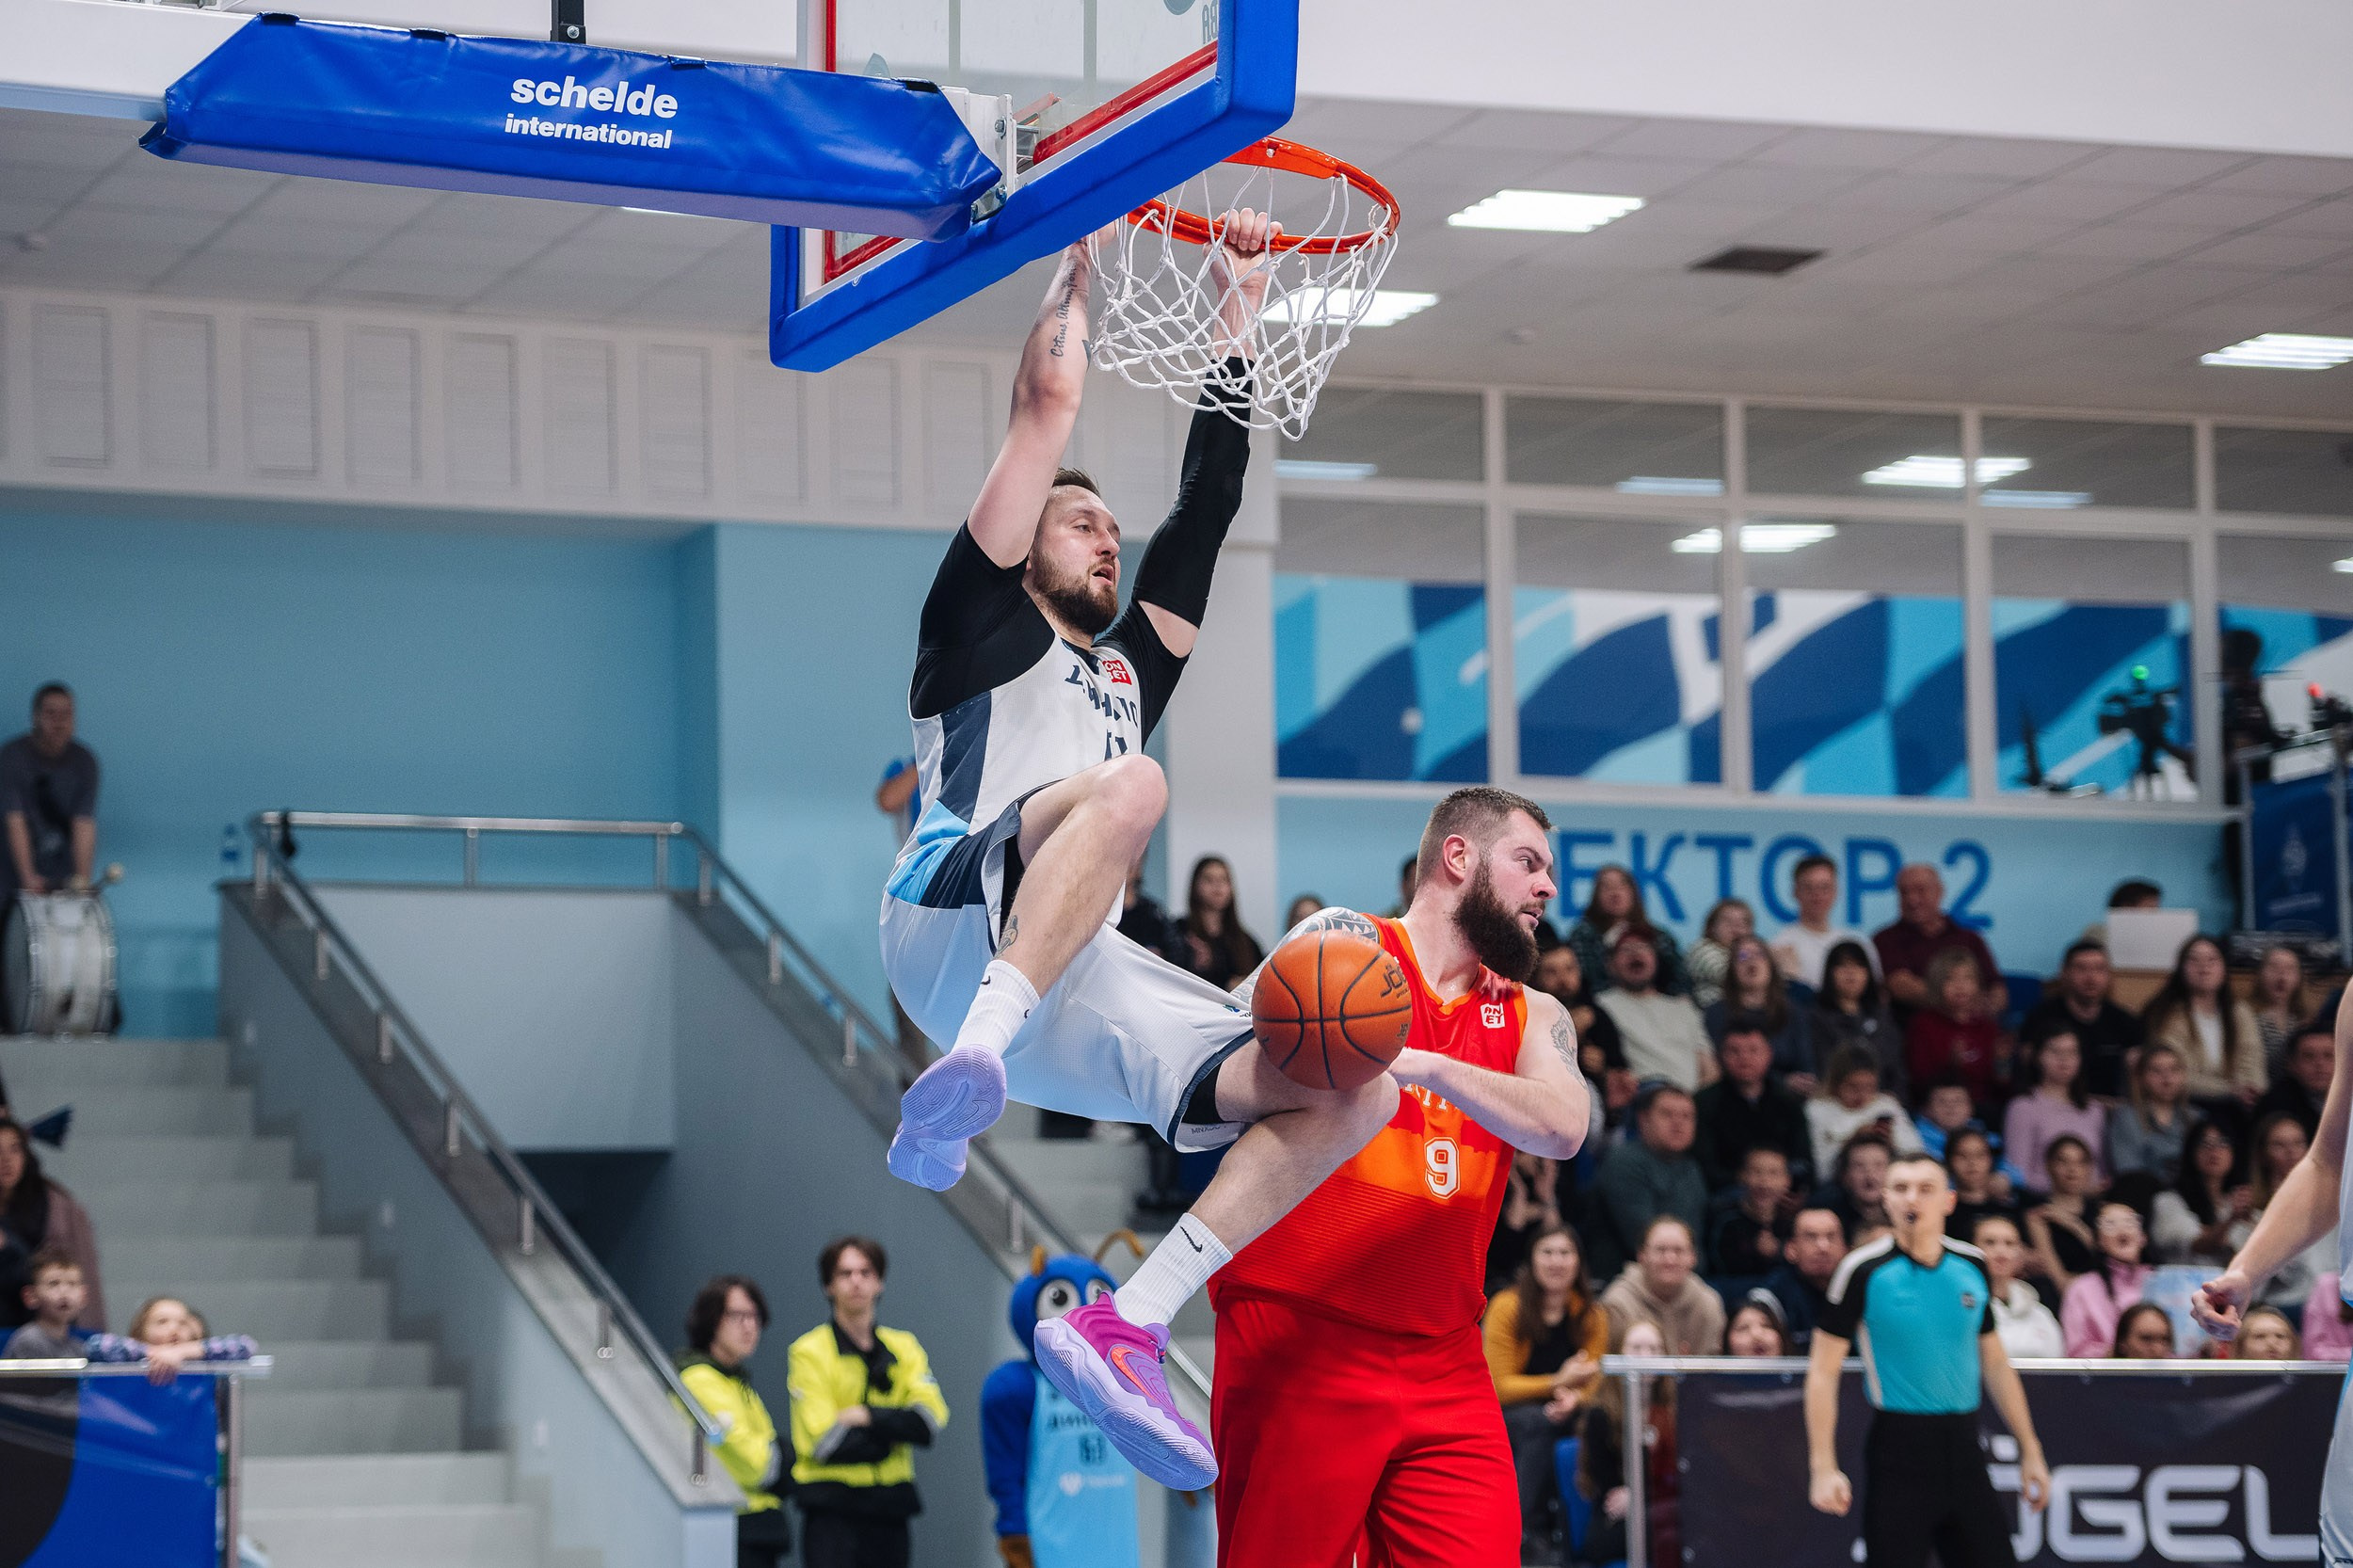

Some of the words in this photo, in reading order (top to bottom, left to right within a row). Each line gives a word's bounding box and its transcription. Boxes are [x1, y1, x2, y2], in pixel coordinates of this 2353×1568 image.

[510, 75, 678, 119] schelde
[504, 113, 672, 149] international
[1558, 828, 1904, 926] ЕКТОР
[1424, 1136, 1460, 1200] 9
